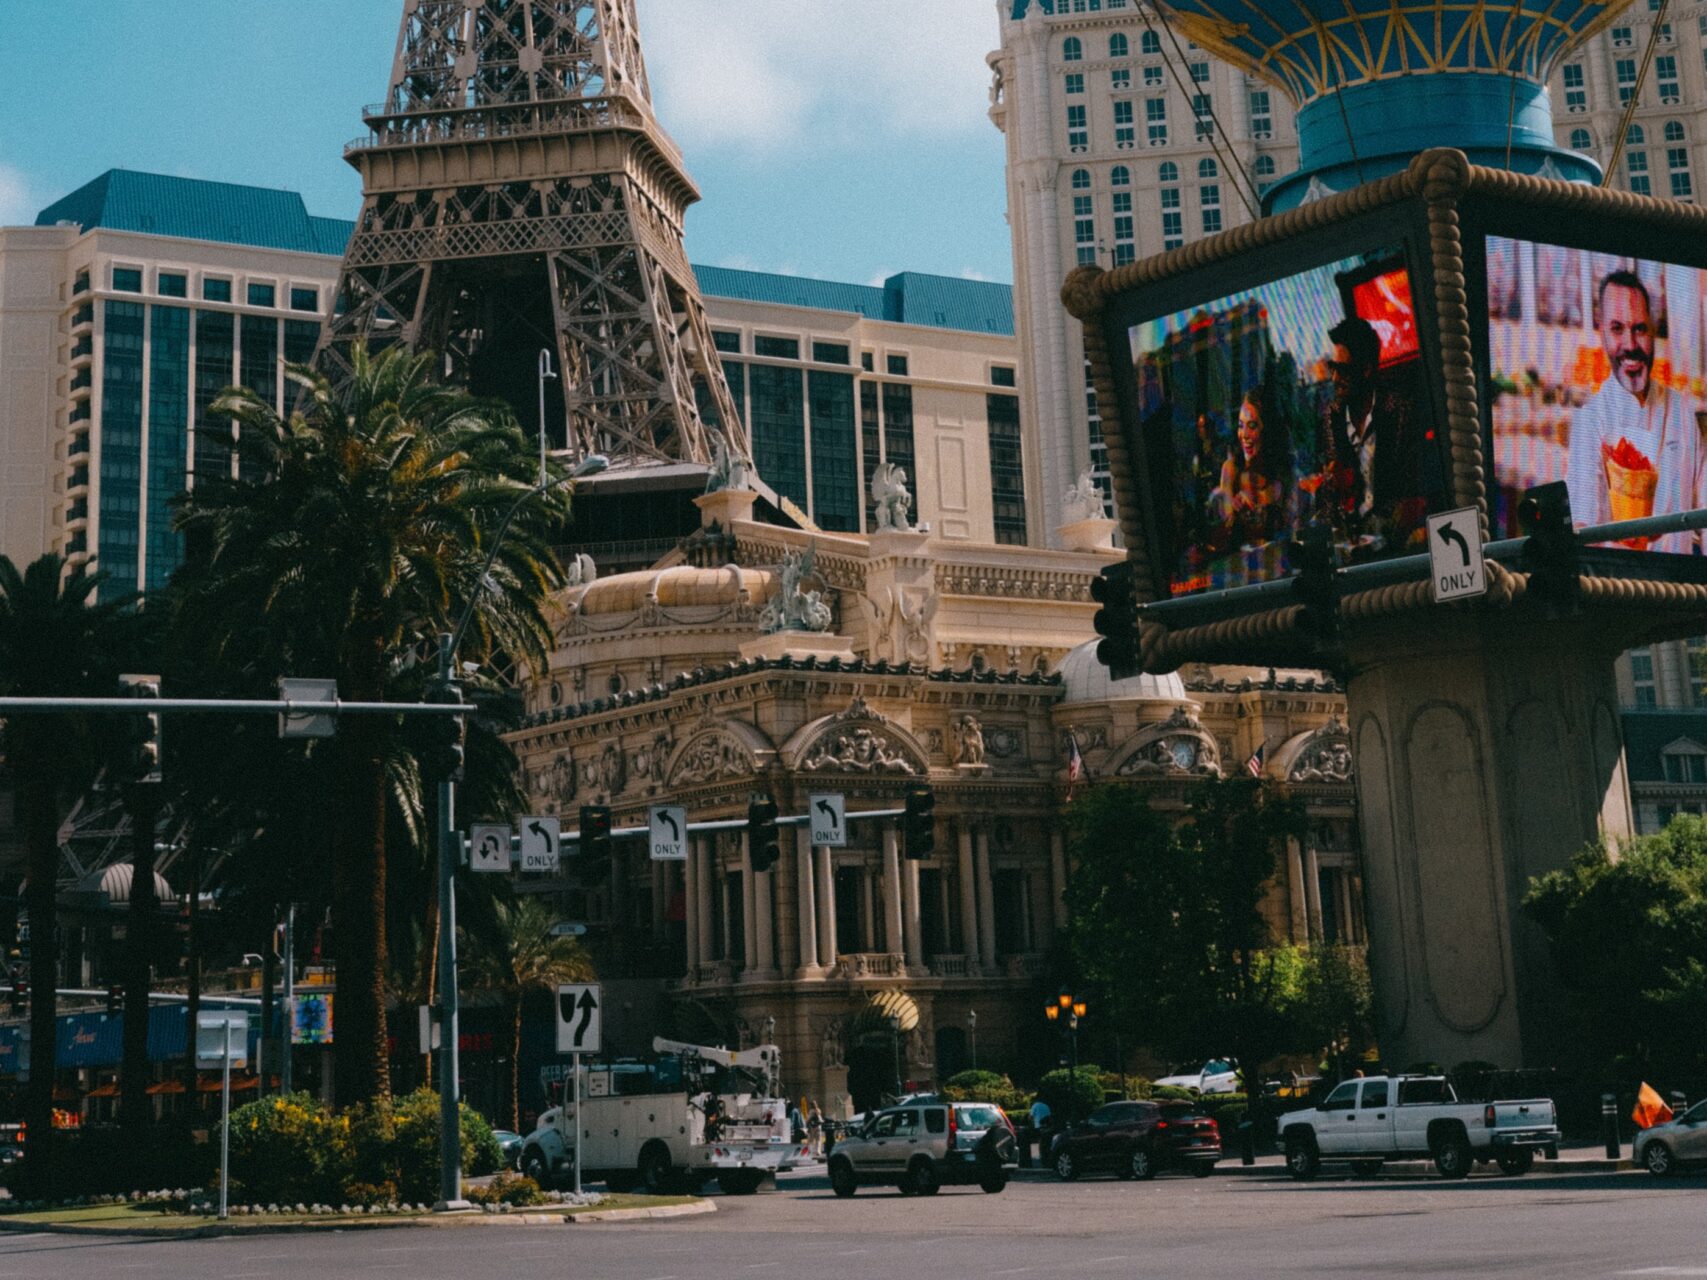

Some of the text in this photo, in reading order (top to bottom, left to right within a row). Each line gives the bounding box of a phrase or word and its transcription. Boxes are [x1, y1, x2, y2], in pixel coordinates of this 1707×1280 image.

[1440, 570, 1476, 593] ONLY
[815, 831, 840, 841] ONLY
[655, 844, 681, 855] ONLY
[526, 855, 555, 867] ONLY
